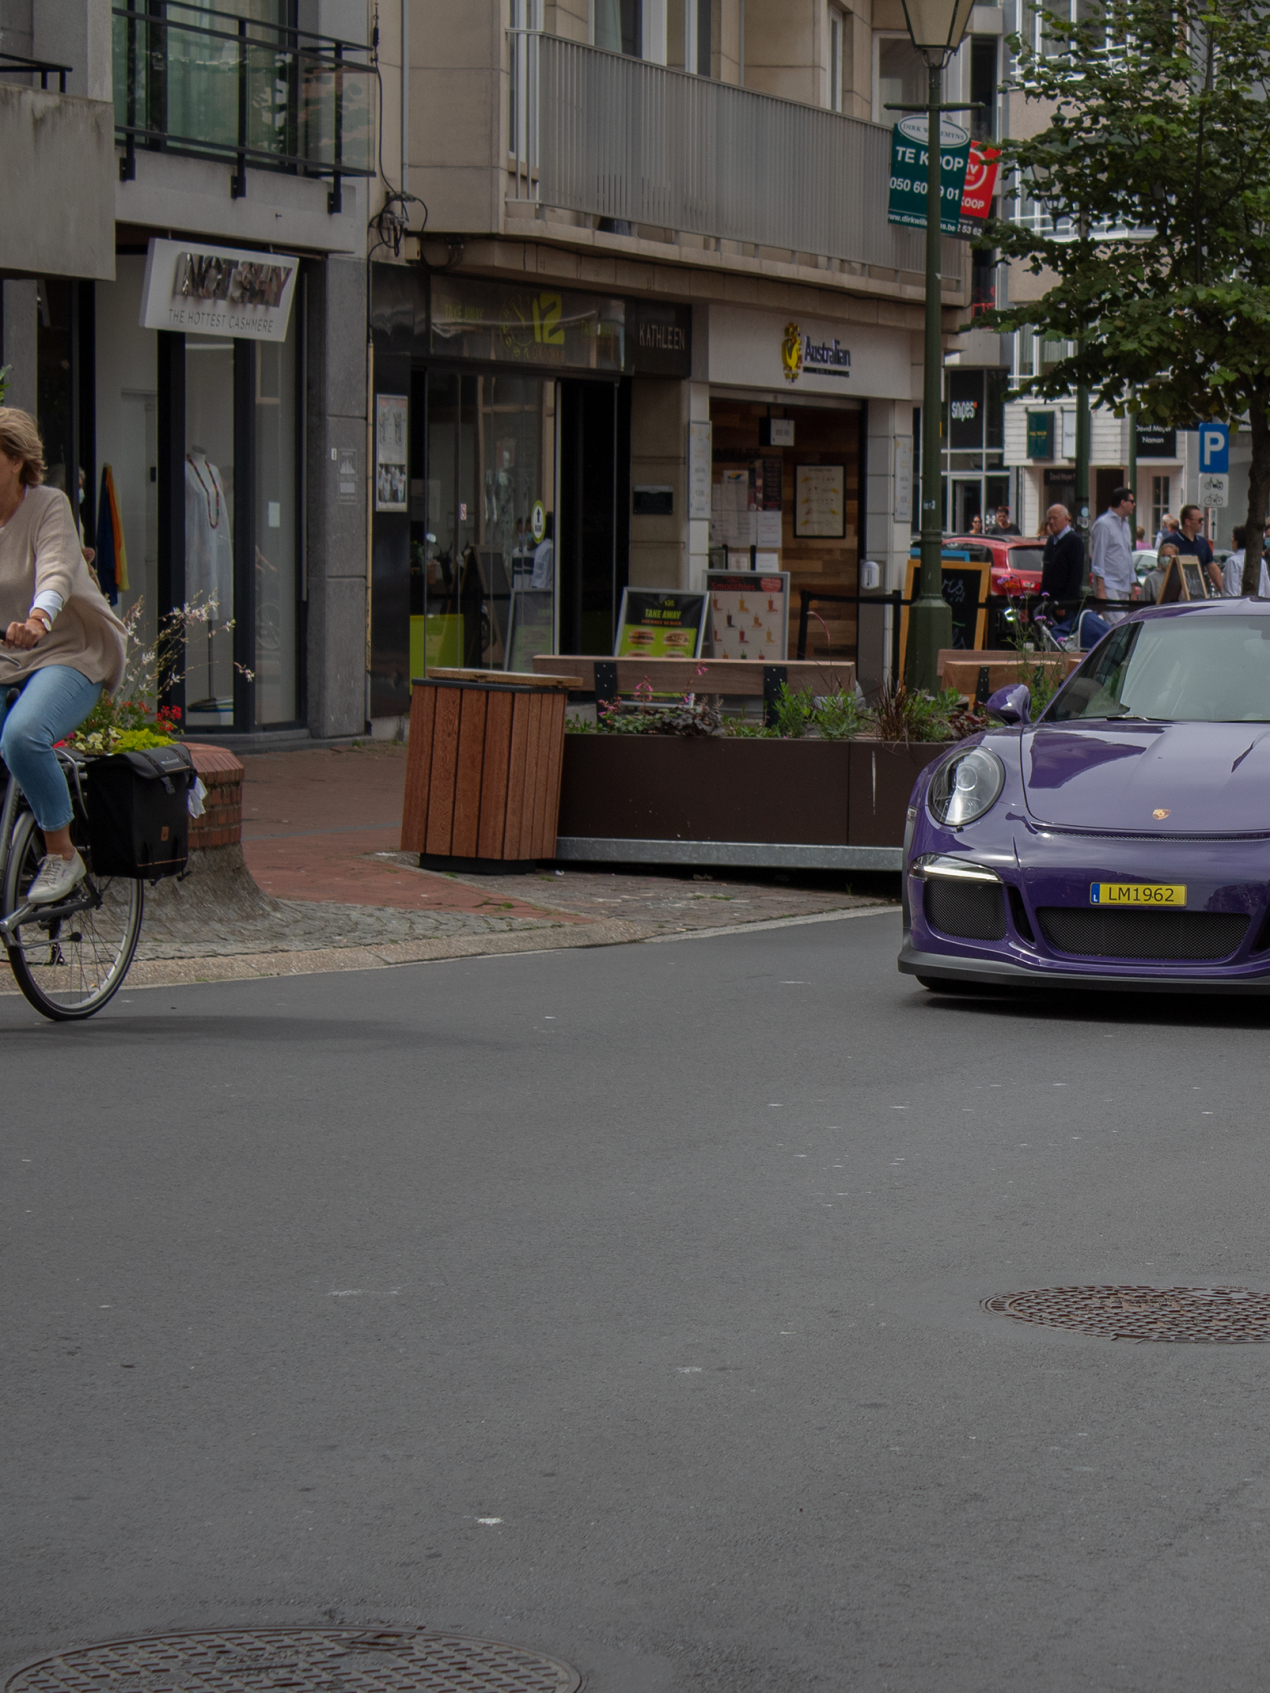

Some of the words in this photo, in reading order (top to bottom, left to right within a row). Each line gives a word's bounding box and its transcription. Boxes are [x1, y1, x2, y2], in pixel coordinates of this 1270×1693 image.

[903, 123, 921, 132] DIRK
[896, 147, 915, 163] TE
[919, 151, 964, 171] KOP
[890, 177, 911, 191] 050
[913, 181, 928, 195] 60
[946, 187, 960, 201] 01
[962, 225, 972, 235] 53
[972, 227, 982, 236] 62
[169, 309, 185, 324] THE
[187, 311, 227, 327] HOTTEST
[228, 315, 274, 333] CASHMERE
[639, 323, 685, 350] KATHLEEN
[803, 336, 851, 367] Australian
[952, 401, 975, 421] snipes
[1204, 431, 1225, 465] P
[711, 582, 756, 591] Smoothies
[645, 608, 661, 619] TAKE
[662, 610, 681, 620] AWAY
[1093, 894, 1098, 902] L
[1108, 887, 1174, 902] LM1962
